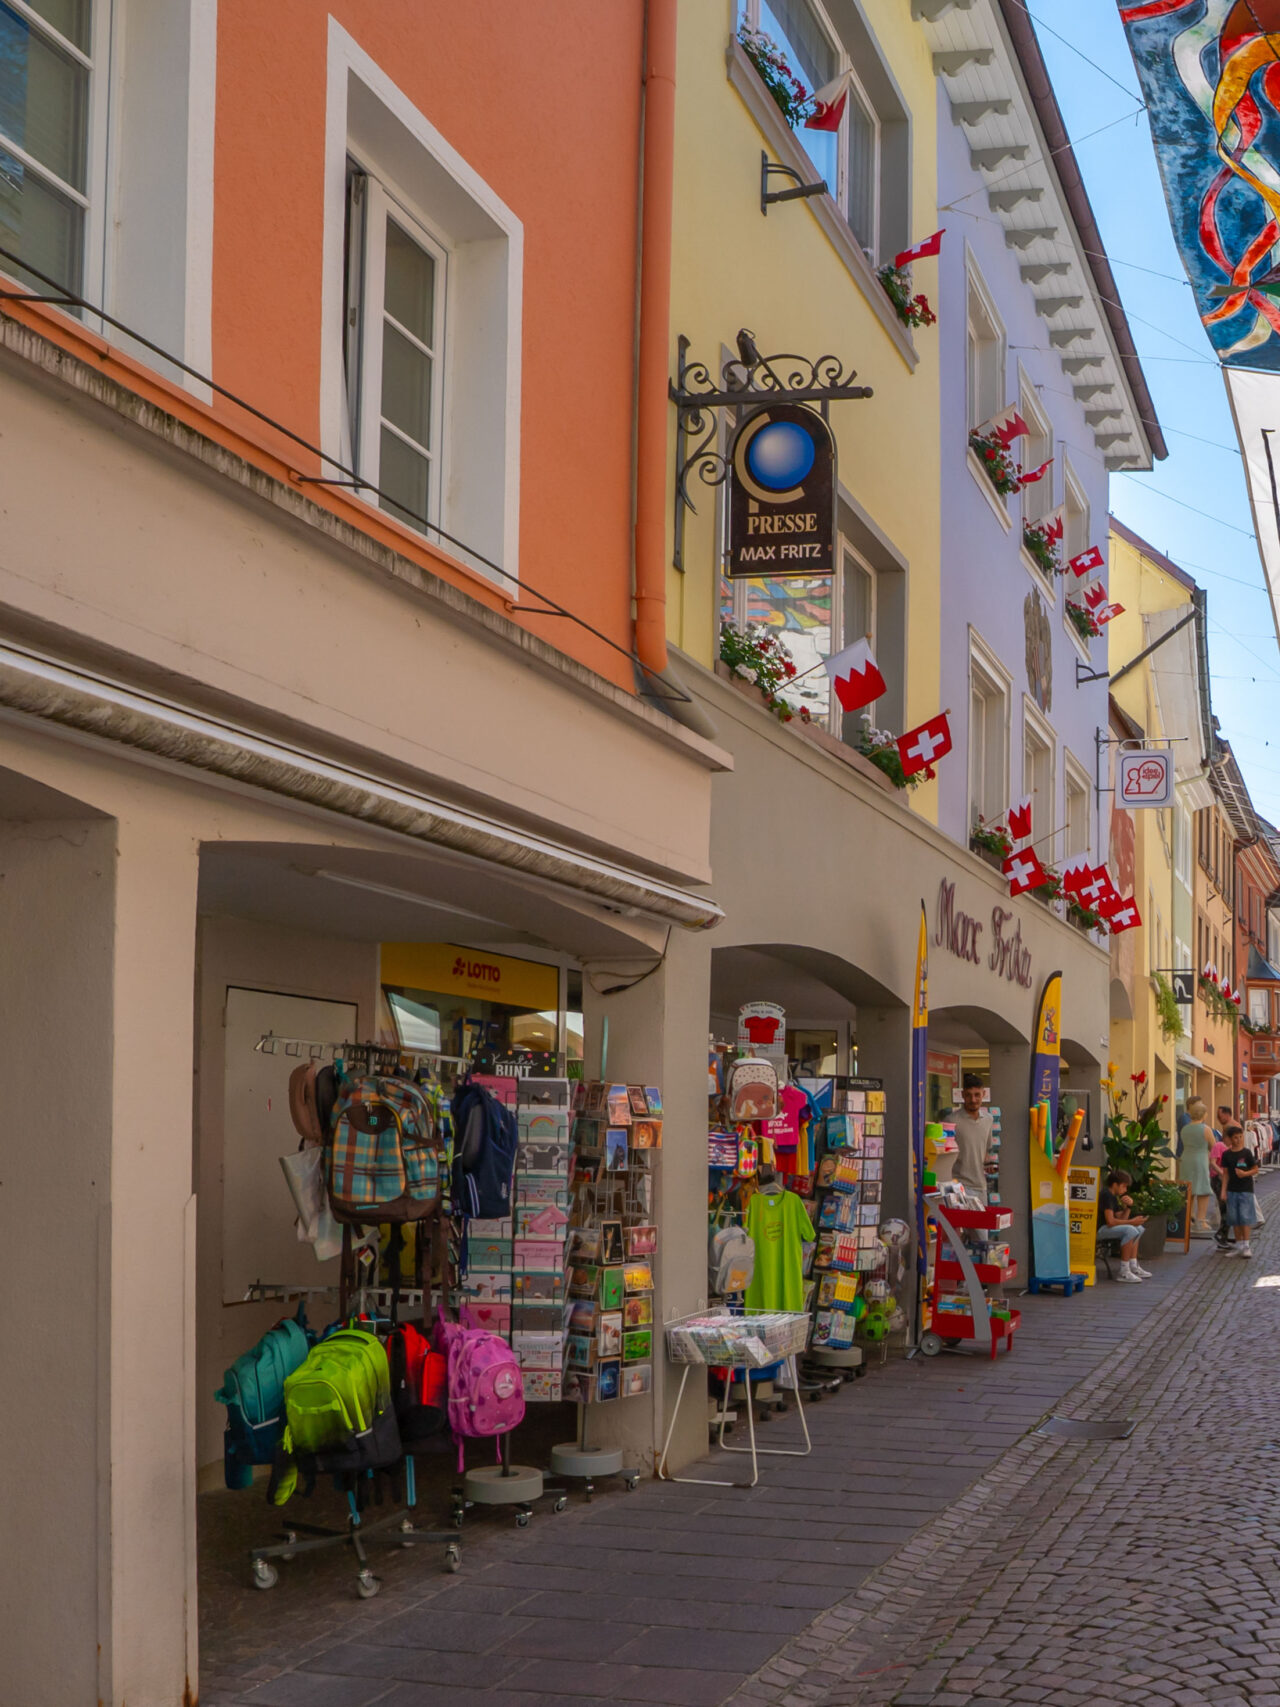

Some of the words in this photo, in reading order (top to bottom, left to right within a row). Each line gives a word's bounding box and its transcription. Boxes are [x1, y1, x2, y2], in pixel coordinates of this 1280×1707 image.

[747, 513, 818, 535] PRESSE
[740, 546, 776, 562] MAX
[781, 543, 822, 559] FRITZ
[936, 876, 983, 965] Max
[467, 961, 501, 982] LOTTO
[495, 1064, 532, 1077] BUNT
